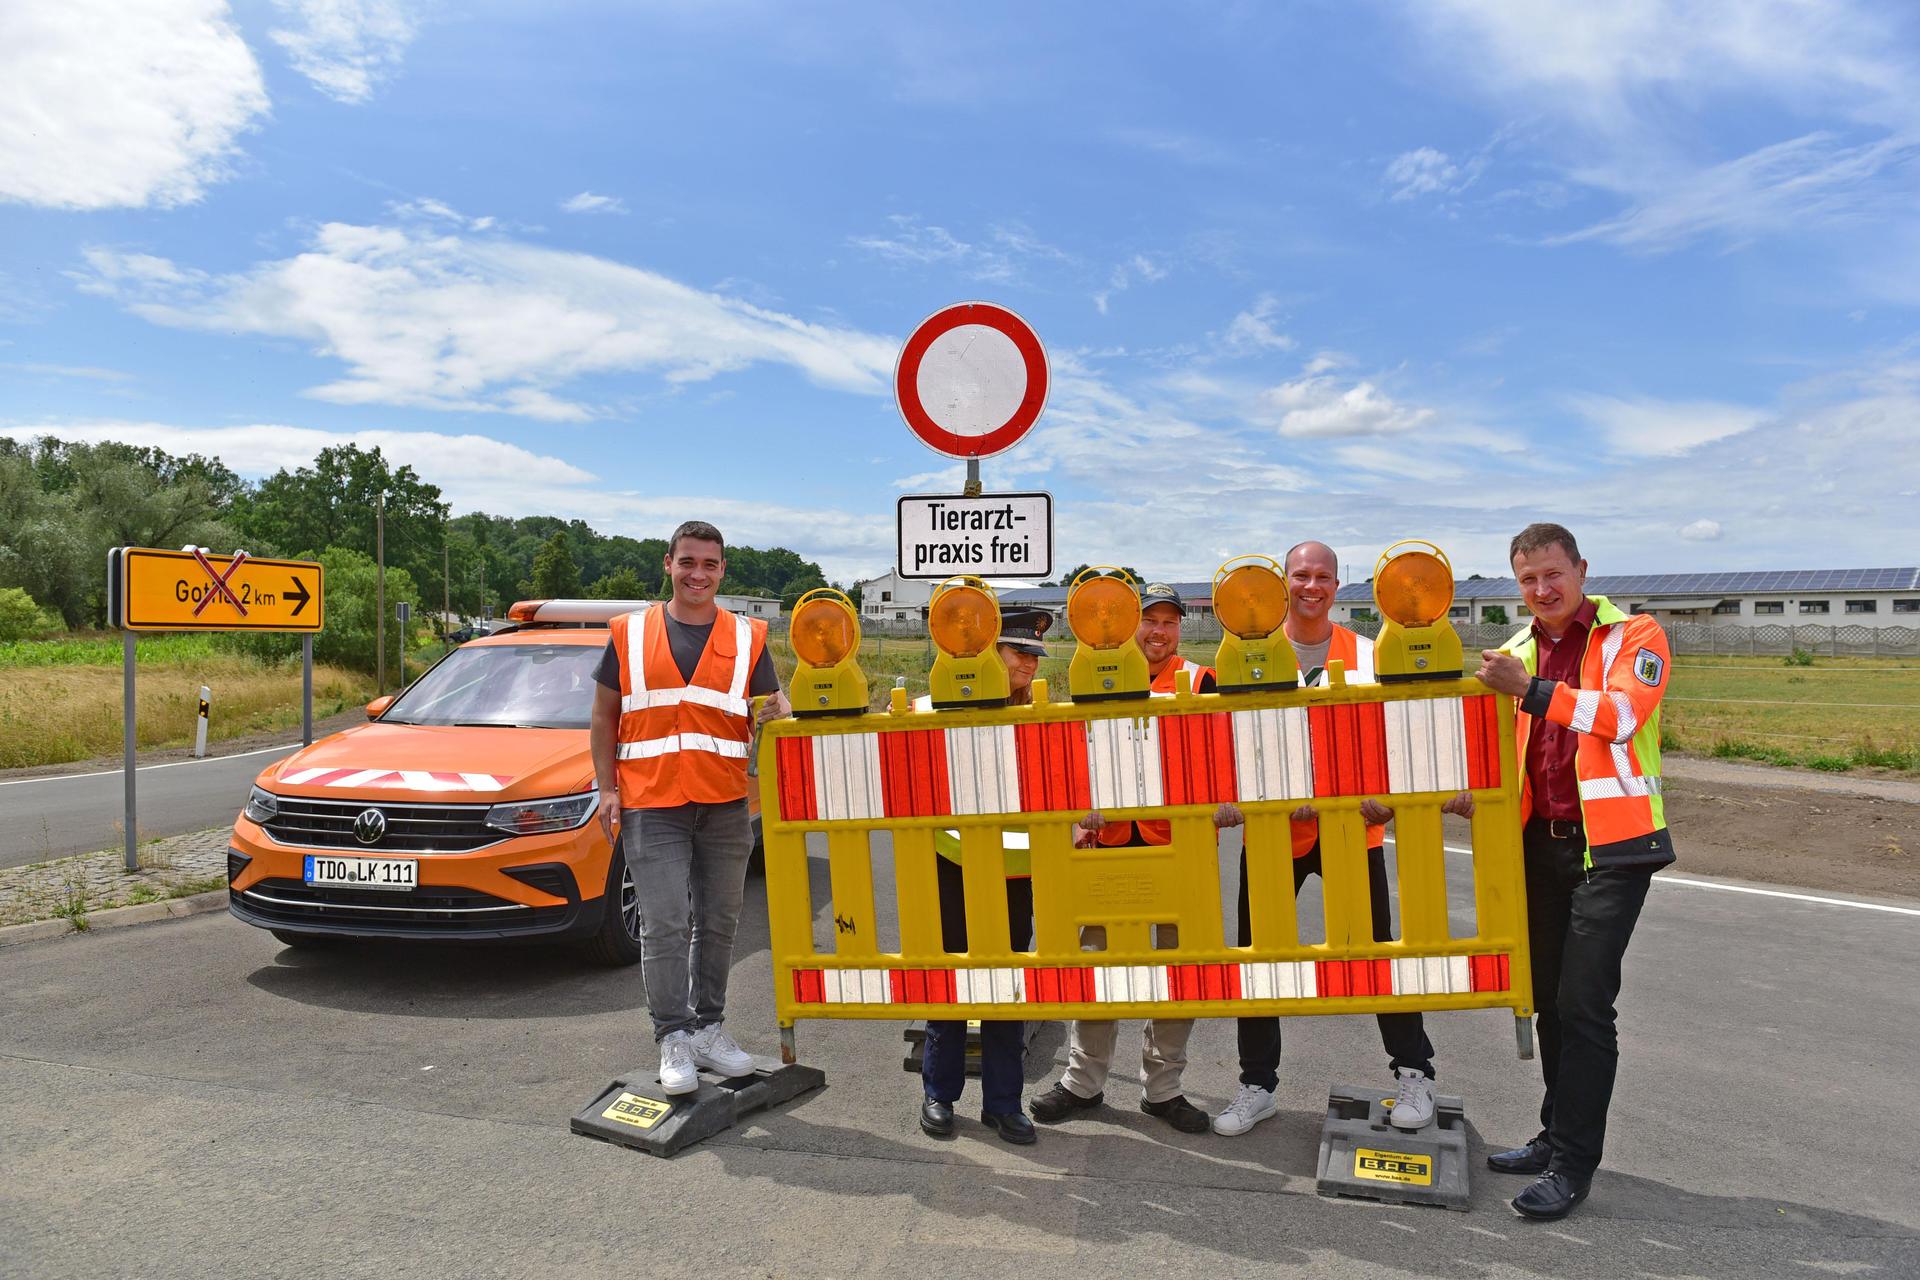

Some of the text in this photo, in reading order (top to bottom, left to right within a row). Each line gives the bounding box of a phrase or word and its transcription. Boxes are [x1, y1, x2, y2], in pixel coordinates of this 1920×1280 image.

[928, 503, 1026, 531] Tierarzt-
[915, 535, 1029, 571] praxis frei
[241, 583, 251, 604] 2
[255, 590, 275, 605] km
[317, 860, 413, 883] TDO LK 111
[1364, 1159, 1425, 1175] B.A.S.
